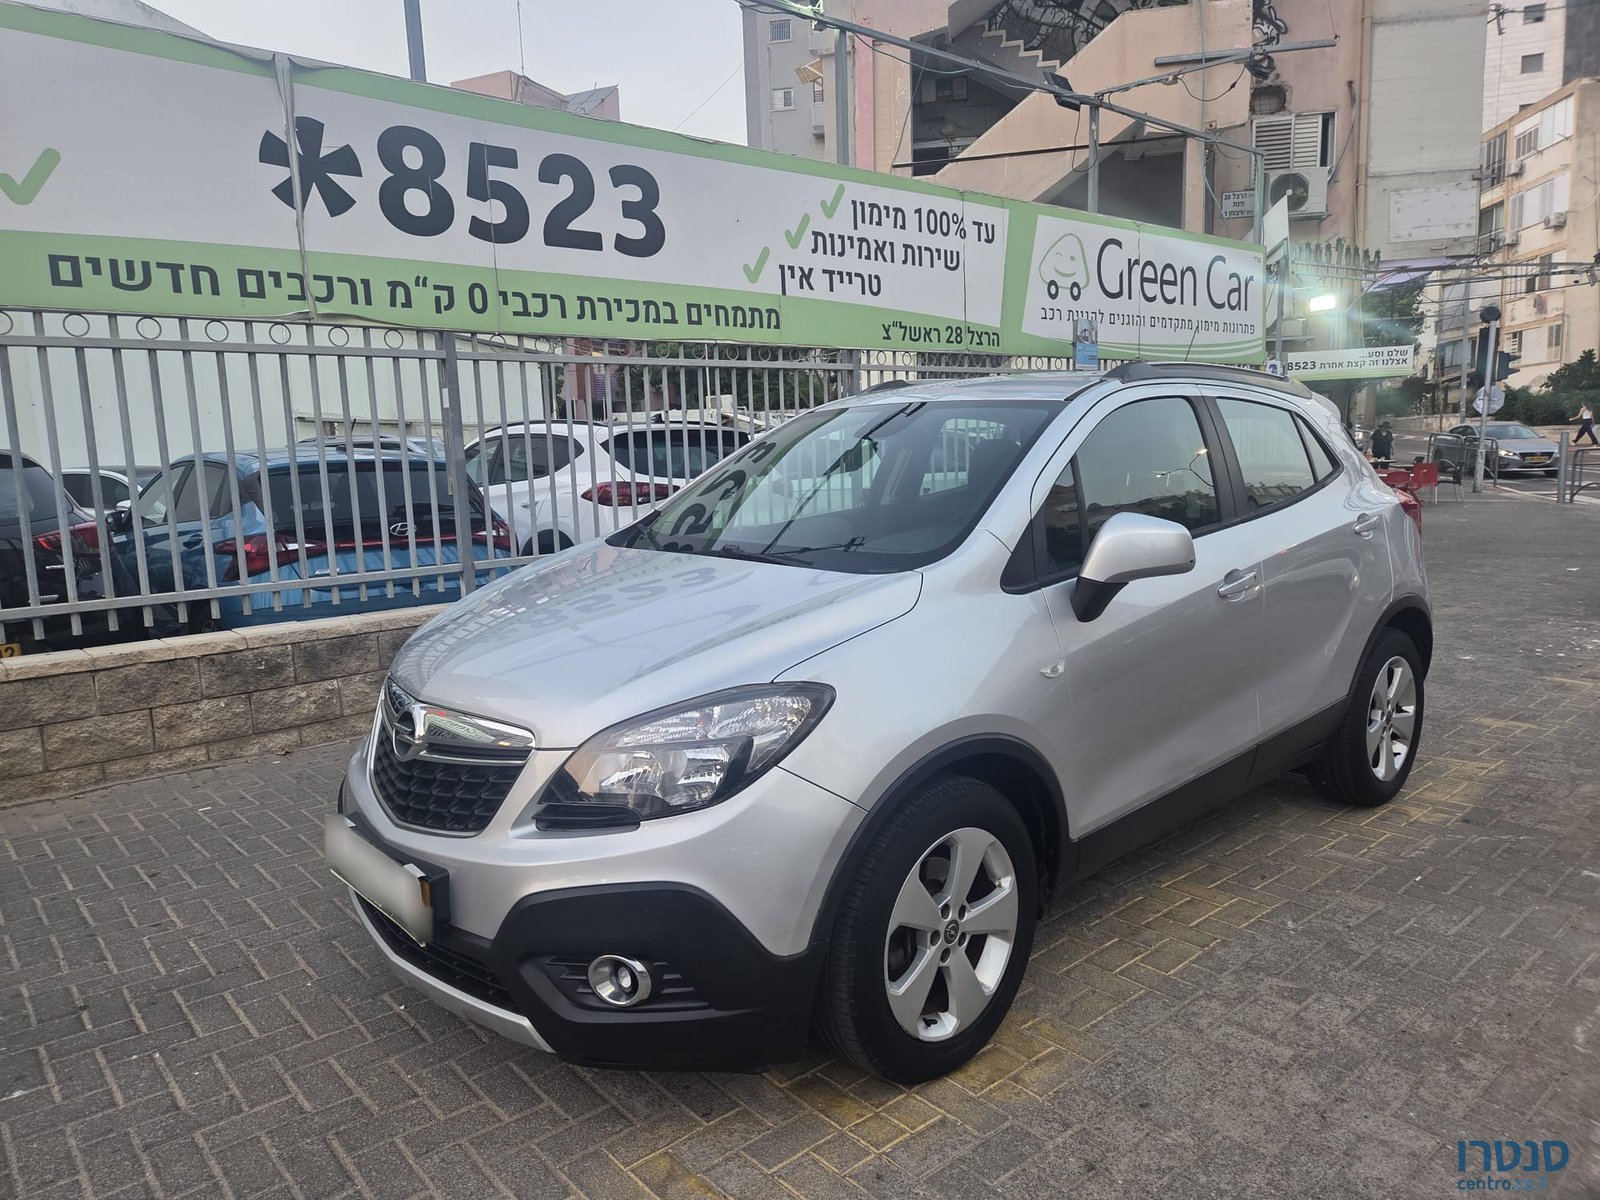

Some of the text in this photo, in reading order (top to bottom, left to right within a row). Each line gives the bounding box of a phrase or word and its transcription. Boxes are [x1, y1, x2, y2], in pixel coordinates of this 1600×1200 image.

[851, 199, 995, 244] עד 100% מימון
[811, 230, 960, 272] שירות ואמינות
[48, 253, 221, 297] חדשים
[237, 268, 373, 307] ורכבים
[778, 264, 882, 297] טרייד אין
[1097, 238, 1254, 312] Green Car
[468, 282, 488, 314] 0
[498, 290, 567, 319] רכבי
[576, 295, 679, 325] במכירת
[687, 302, 781, 330] מתמחים
[1041, 307, 1062, 321] רכב
[1109, 312, 1146, 327] והוגנים
[1150, 316, 1193, 332] מתקדמים
[1197, 319, 1219, 334] מימון
[1222, 321, 1255, 334] פתרונות
[881, 321, 1000, 348] הרצל 28 ראשל"צ
[1319, 361, 1344, 370] אחרת
[1346, 360, 1366, 369] קצת
[1369, 359, 1380, 367] זה
[1382, 357, 1408, 366] אצלנו
[1387, 348, 1408, 357] שלם
